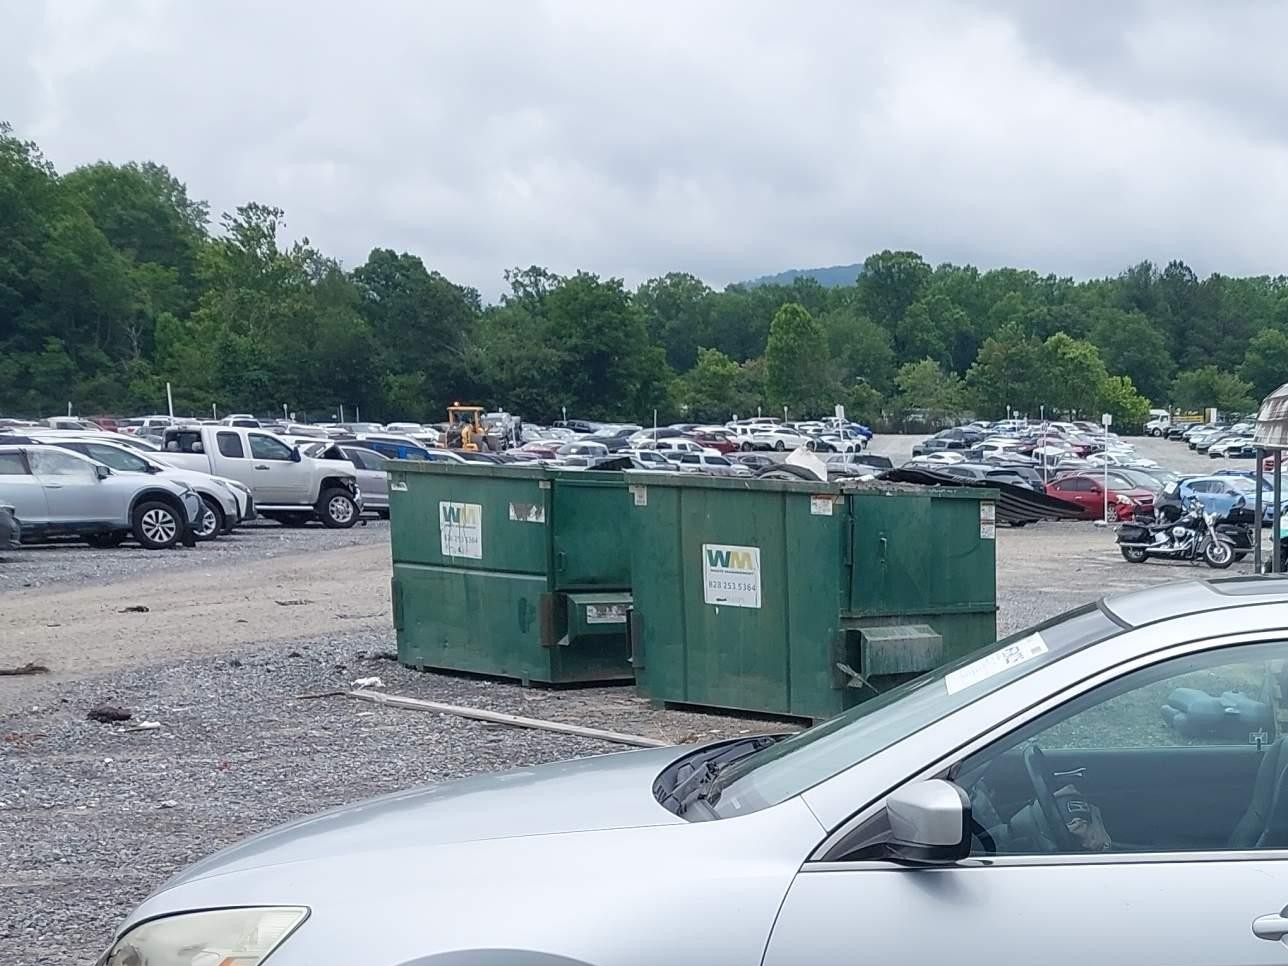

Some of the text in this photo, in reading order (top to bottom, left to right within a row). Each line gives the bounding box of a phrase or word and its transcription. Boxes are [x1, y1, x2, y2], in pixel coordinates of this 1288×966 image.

[707, 549, 753, 570] WM
[723, 581, 736, 590] 253
[737, 582, 757, 592] 5364
